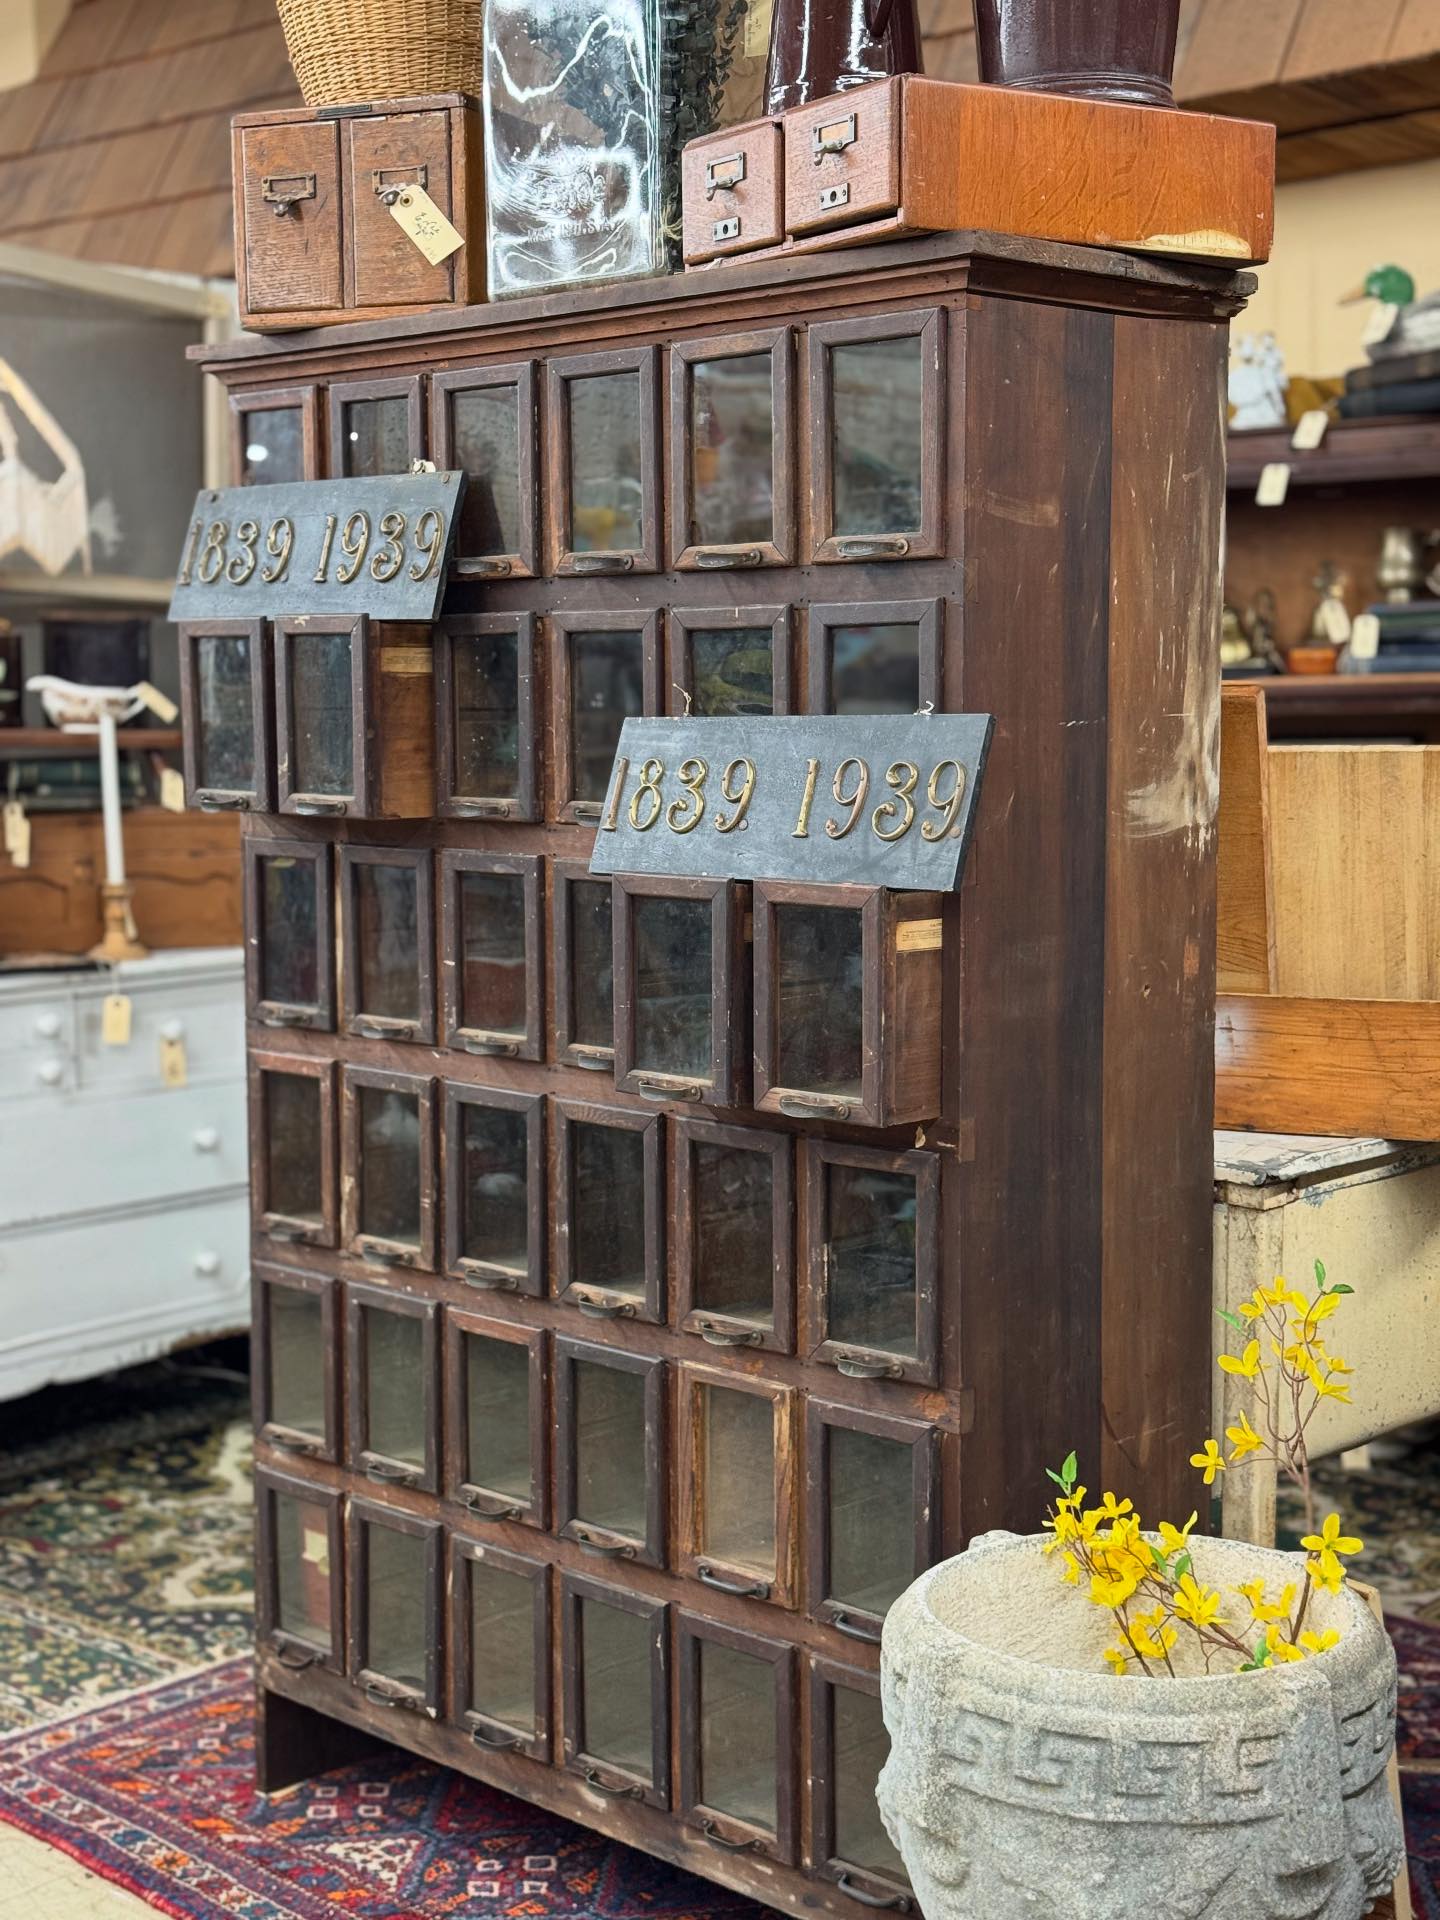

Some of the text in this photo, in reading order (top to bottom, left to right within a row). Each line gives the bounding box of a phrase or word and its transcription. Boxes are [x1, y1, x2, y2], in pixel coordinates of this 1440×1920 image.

[178, 510, 445, 585] 1839 1939
[601, 756, 967, 842] 1839 1939
